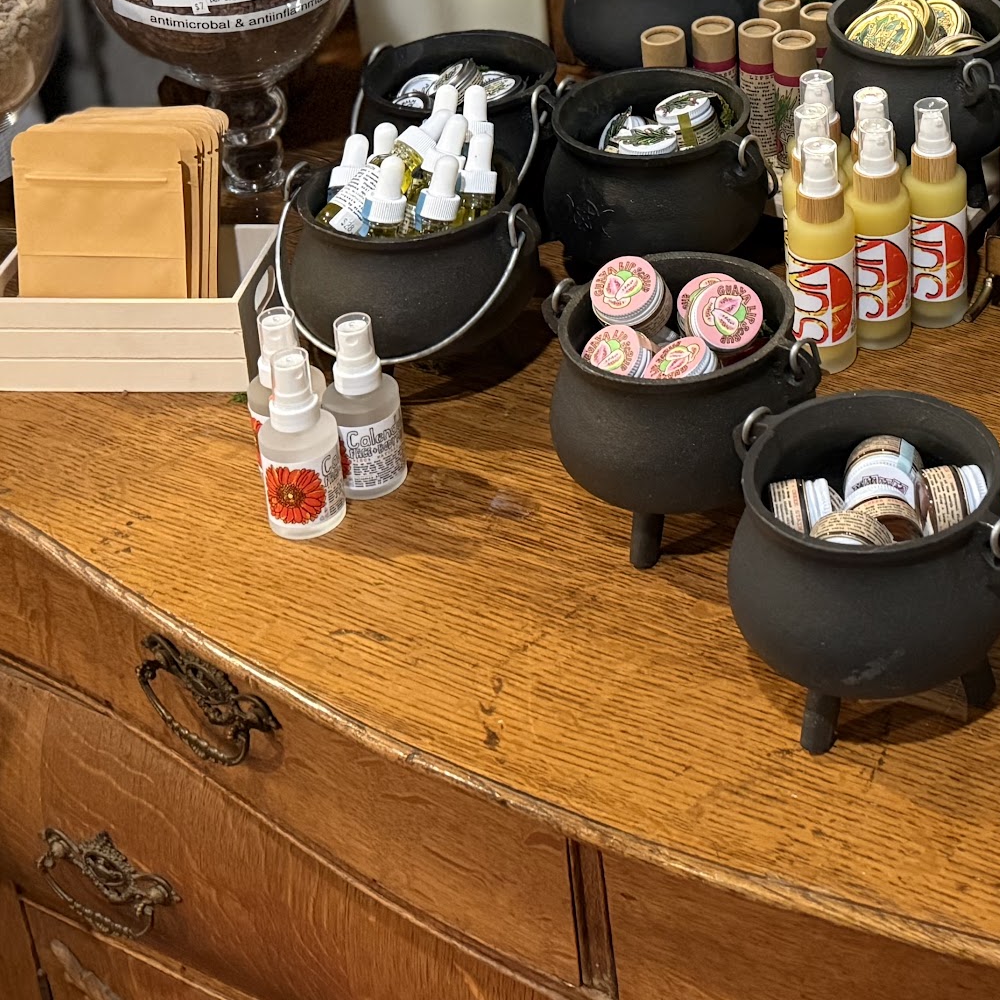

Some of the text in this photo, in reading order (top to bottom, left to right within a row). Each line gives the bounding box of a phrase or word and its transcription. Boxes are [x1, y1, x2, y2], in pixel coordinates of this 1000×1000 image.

[150, 14, 231, 30] antimicrobal
[235, 18, 245, 29] &
[594, 261, 652, 297] GUAVA LIP SCRUB
[717, 285, 758, 345] GUAVA LIP SCRUB
[613, 329, 627, 341] LIP
